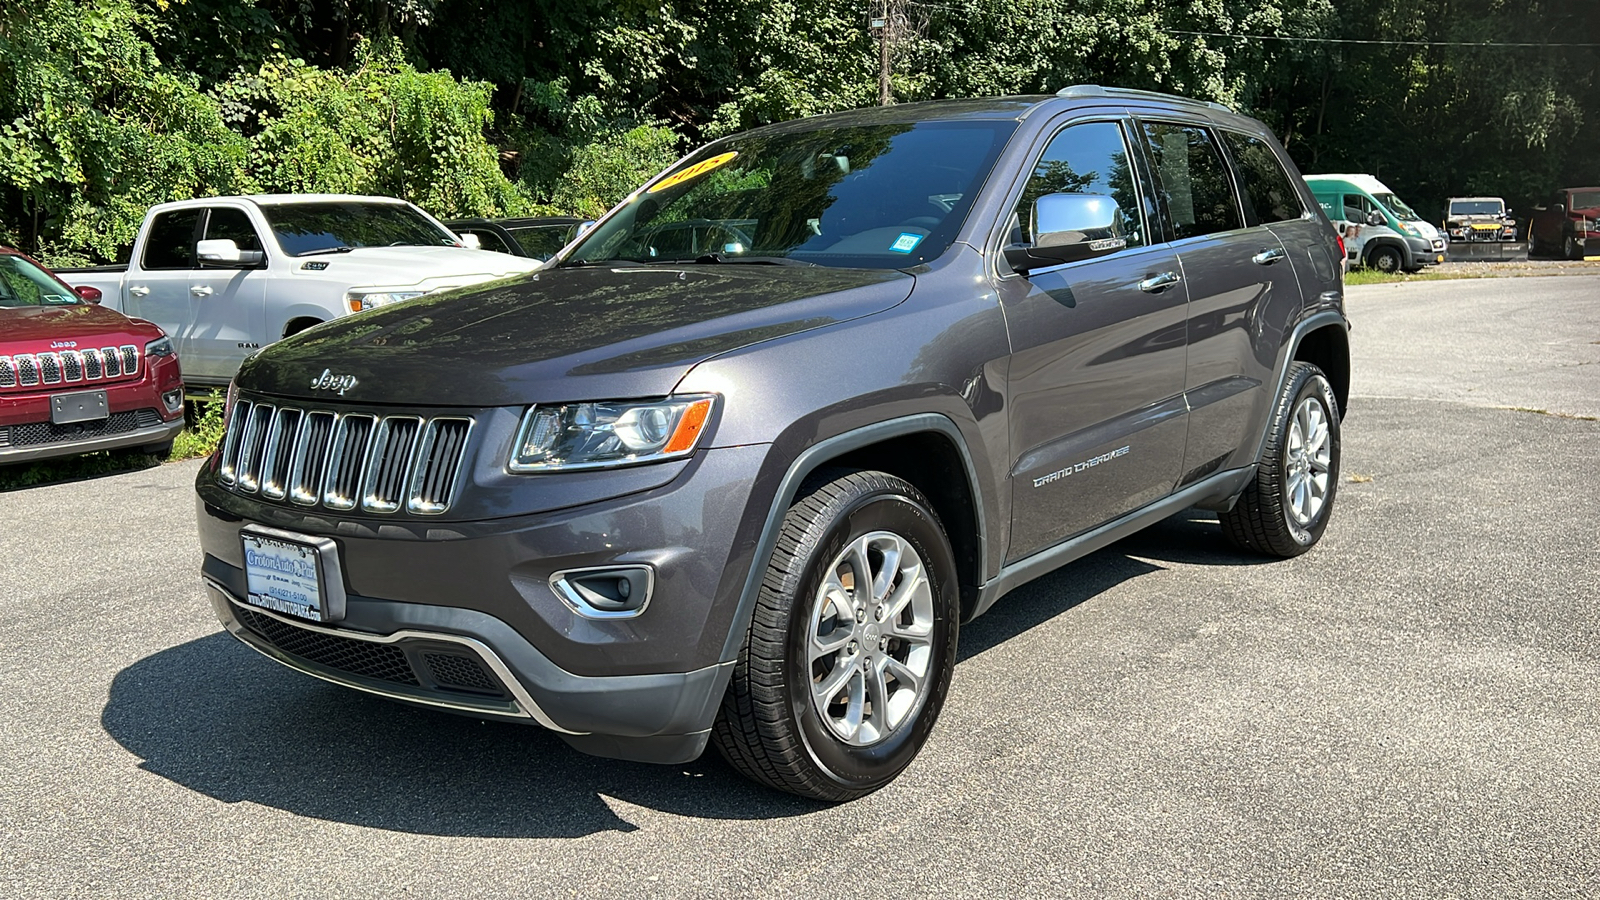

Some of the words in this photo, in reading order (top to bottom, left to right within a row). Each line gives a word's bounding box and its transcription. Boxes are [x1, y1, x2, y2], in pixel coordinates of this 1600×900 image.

[660, 155, 724, 188] 2015
[50, 340, 78, 348] Jeep
[310, 368, 358, 396] Jeep
[1033, 466, 1073, 488] GRAND
[1074, 445, 1130, 472] CHEROKEE
[269, 586, 308, 602] (914)271-5100
